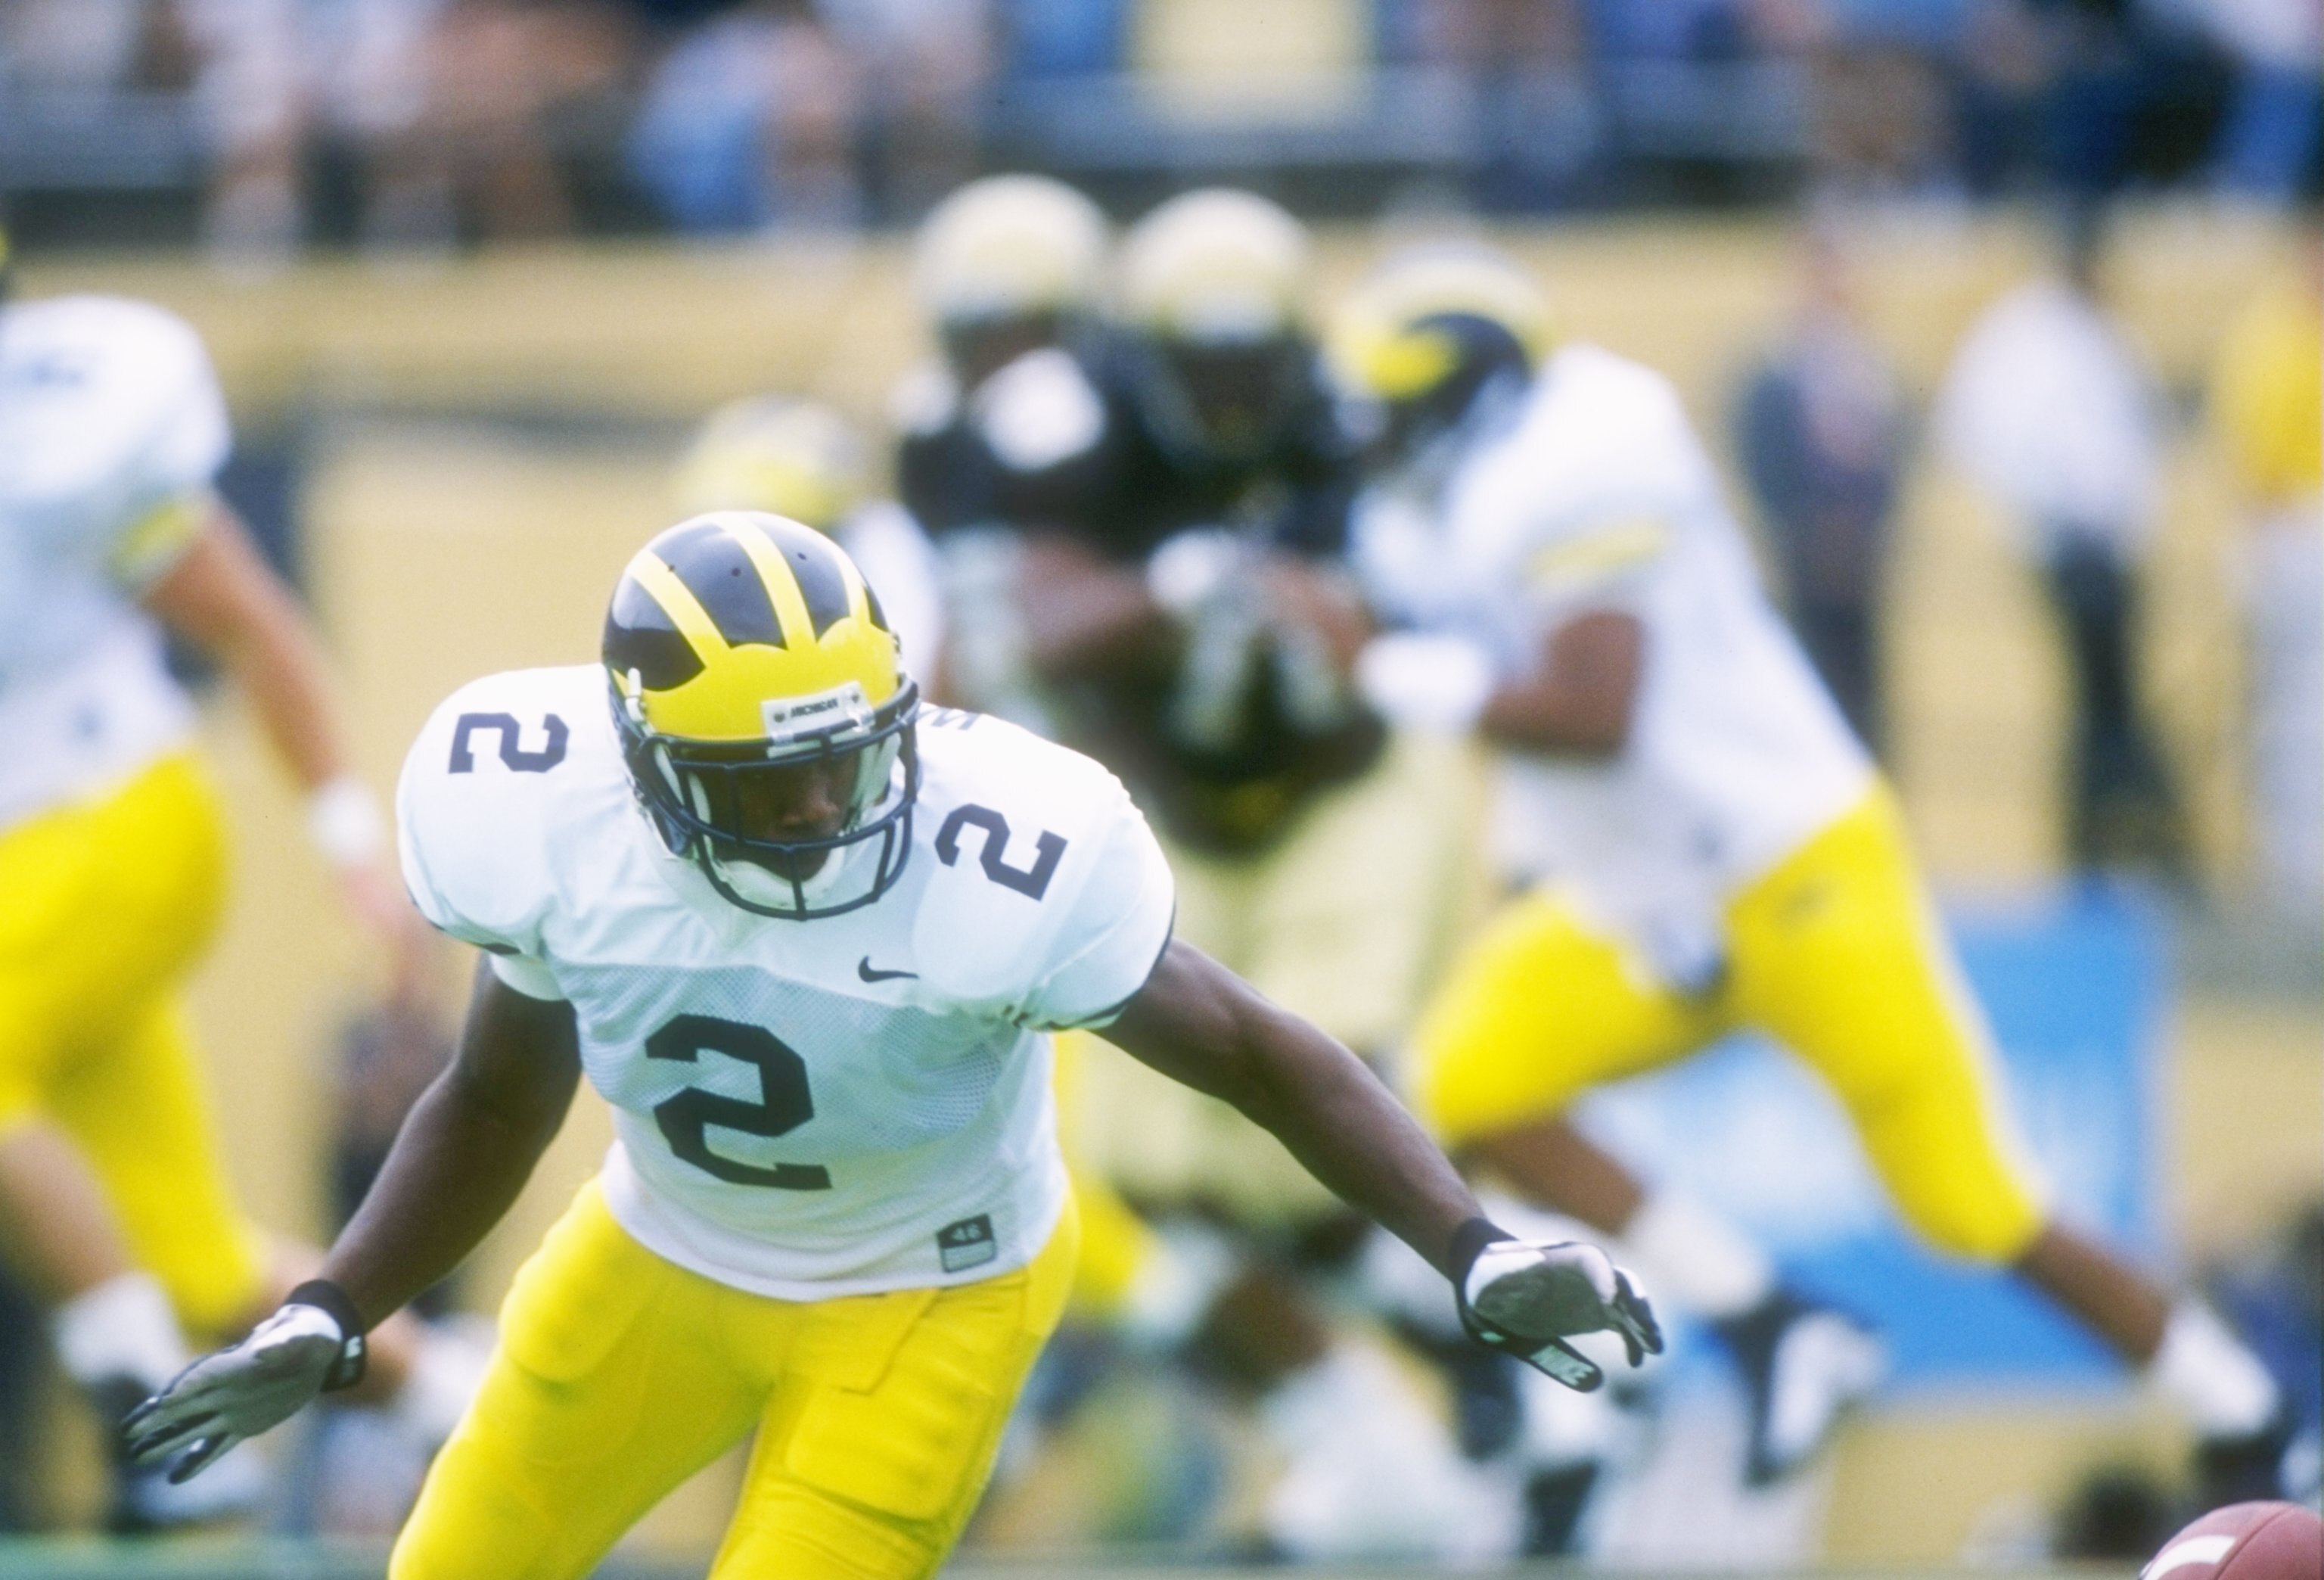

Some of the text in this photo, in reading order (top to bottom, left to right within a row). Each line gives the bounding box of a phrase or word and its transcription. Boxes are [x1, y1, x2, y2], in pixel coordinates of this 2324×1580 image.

[448, 712, 570, 773] 2
[934, 803, 1068, 901] 2
[645, 1012, 833, 1191] 2
